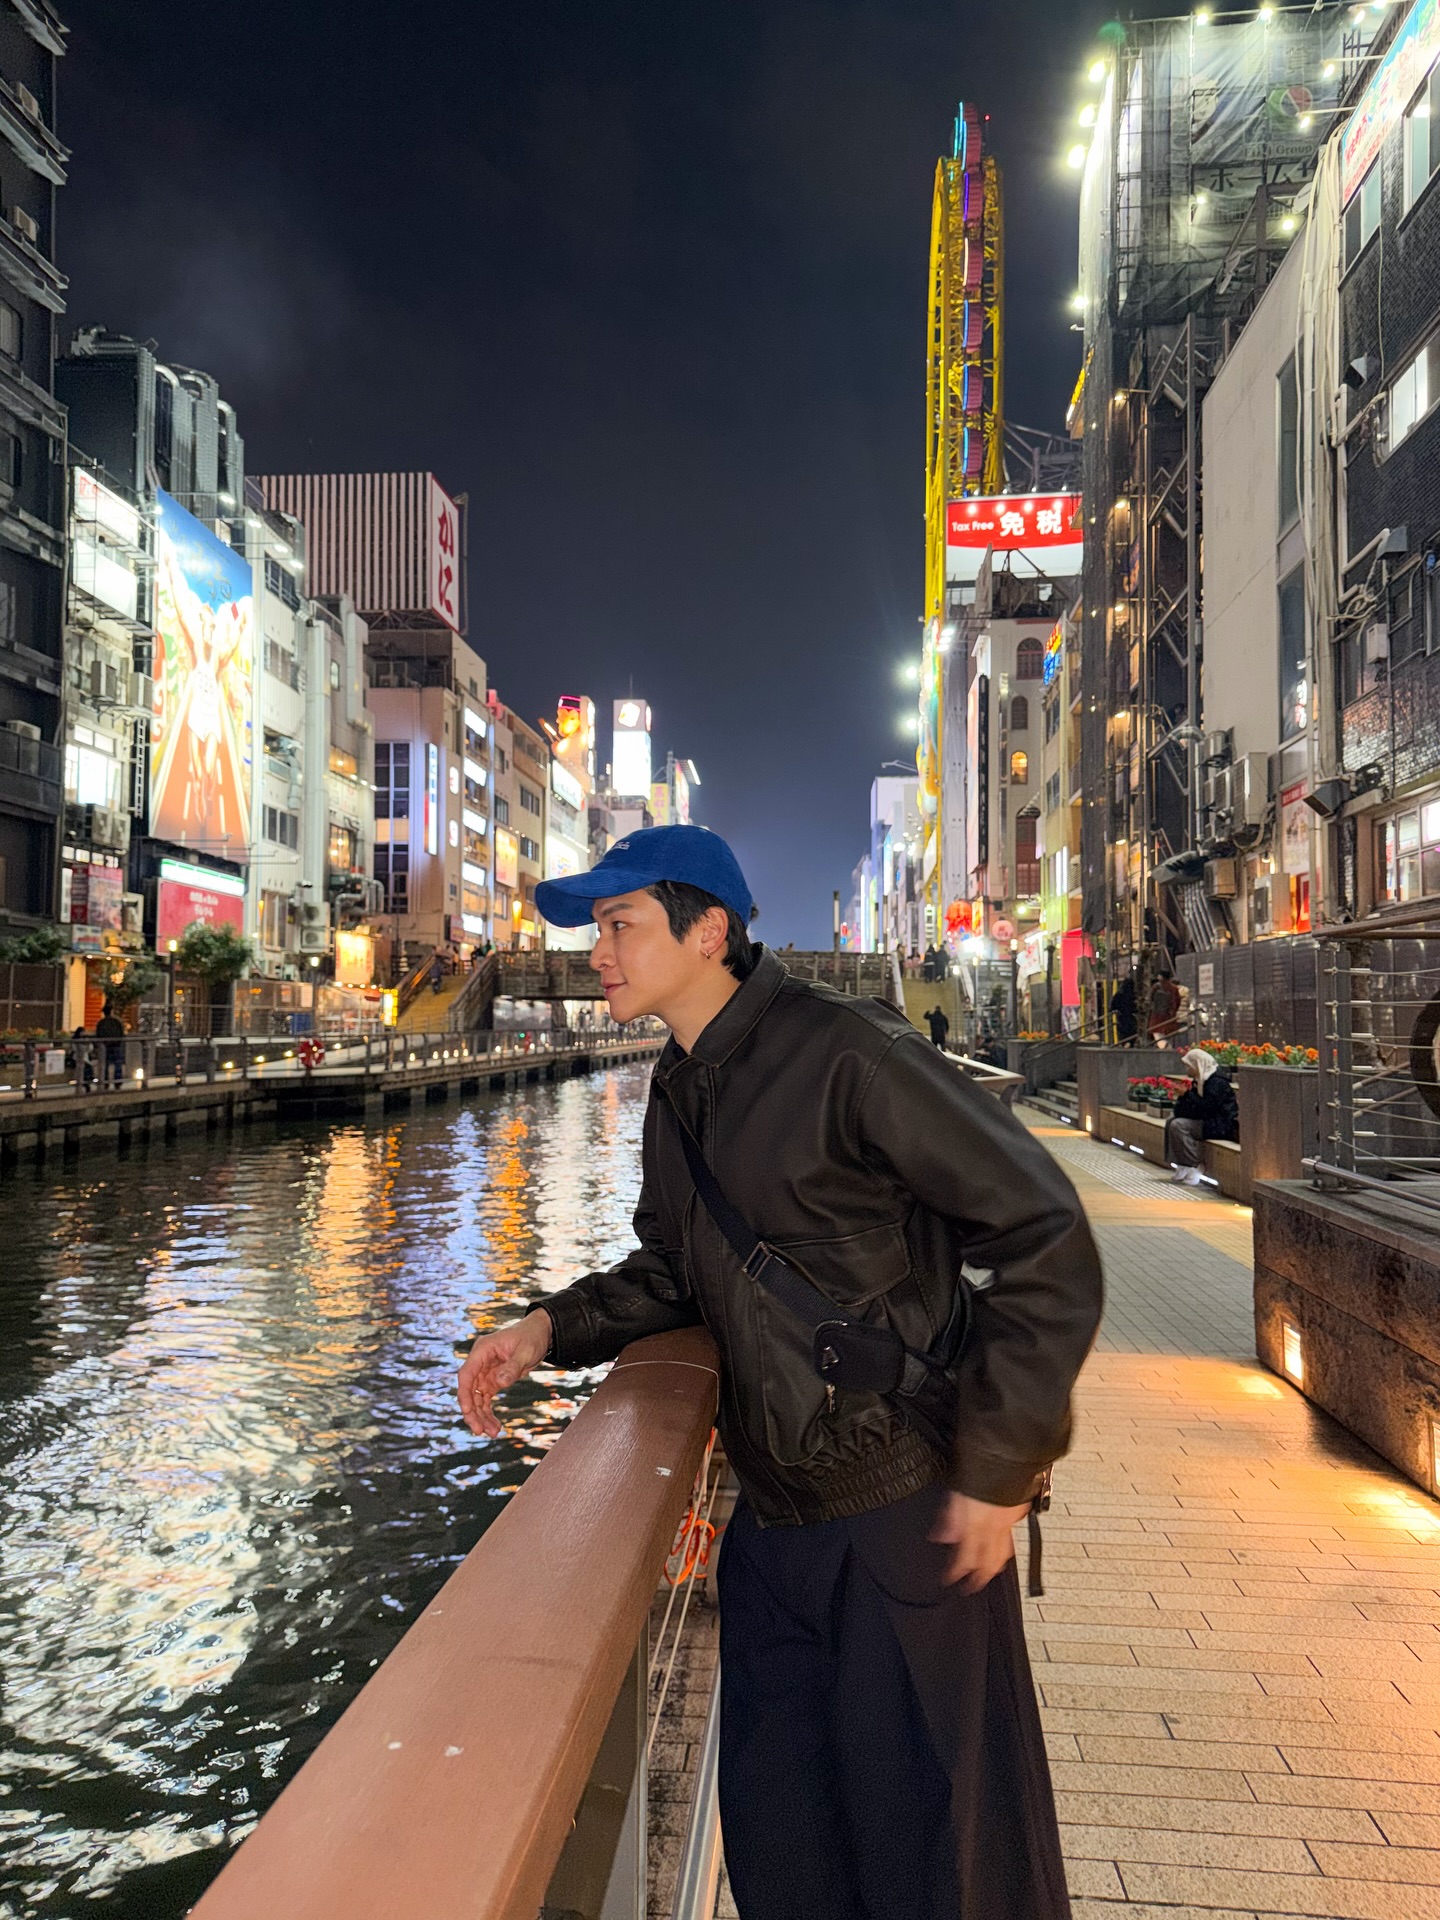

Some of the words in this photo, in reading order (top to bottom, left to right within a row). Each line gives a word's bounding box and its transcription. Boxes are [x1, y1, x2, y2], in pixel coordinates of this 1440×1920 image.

[1275, 144, 1313, 155] Group
[952, 522, 970, 532] Tax
[972, 521, 994, 531] Free
[999, 510, 1063, 537] 免税
[438, 501, 454, 618] かに
